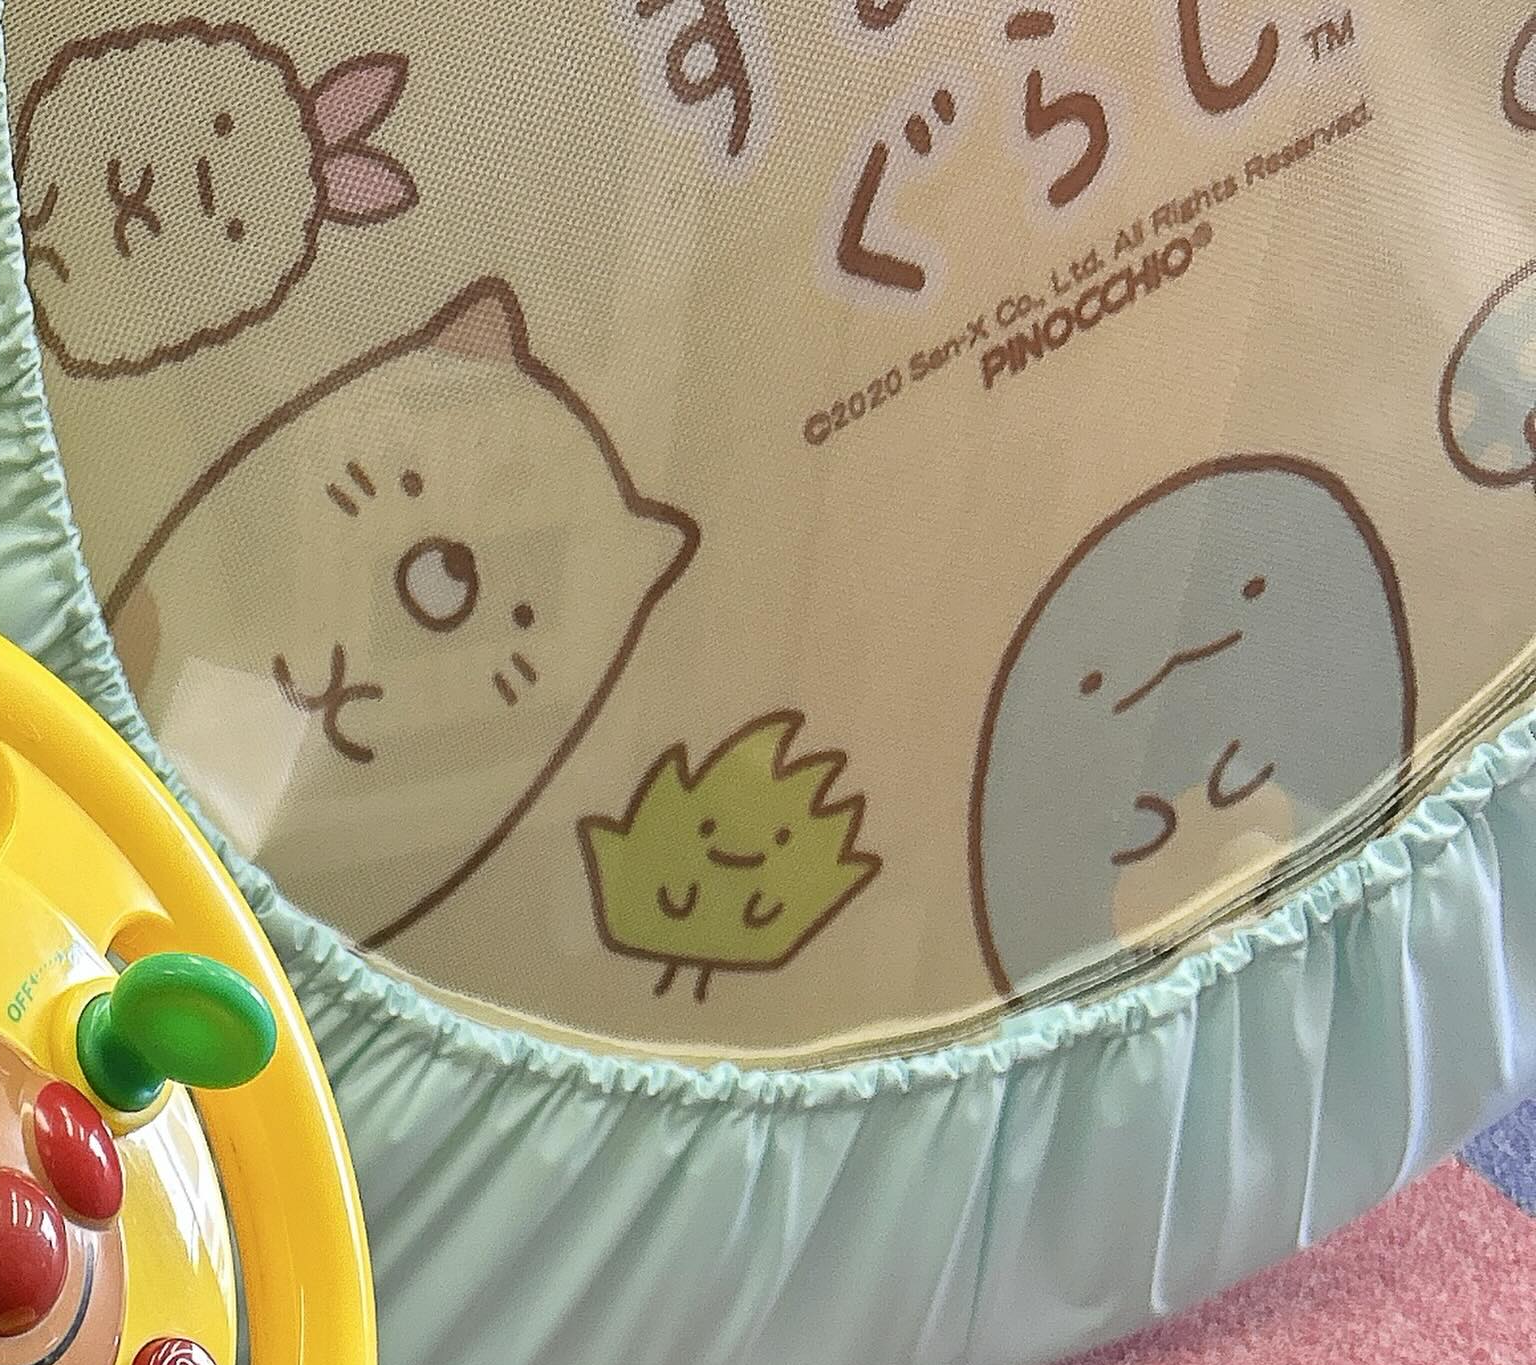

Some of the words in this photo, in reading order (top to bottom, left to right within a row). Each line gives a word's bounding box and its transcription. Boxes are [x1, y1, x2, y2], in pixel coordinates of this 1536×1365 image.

[1304, 11, 1355, 61] TM
[804, 366, 902, 446] ©2020
[1051, 250, 1104, 294] Ltd.
[1114, 217, 1144, 259] All
[1150, 175, 1237, 234] Rights
[7, 978, 34, 1023] OFF
